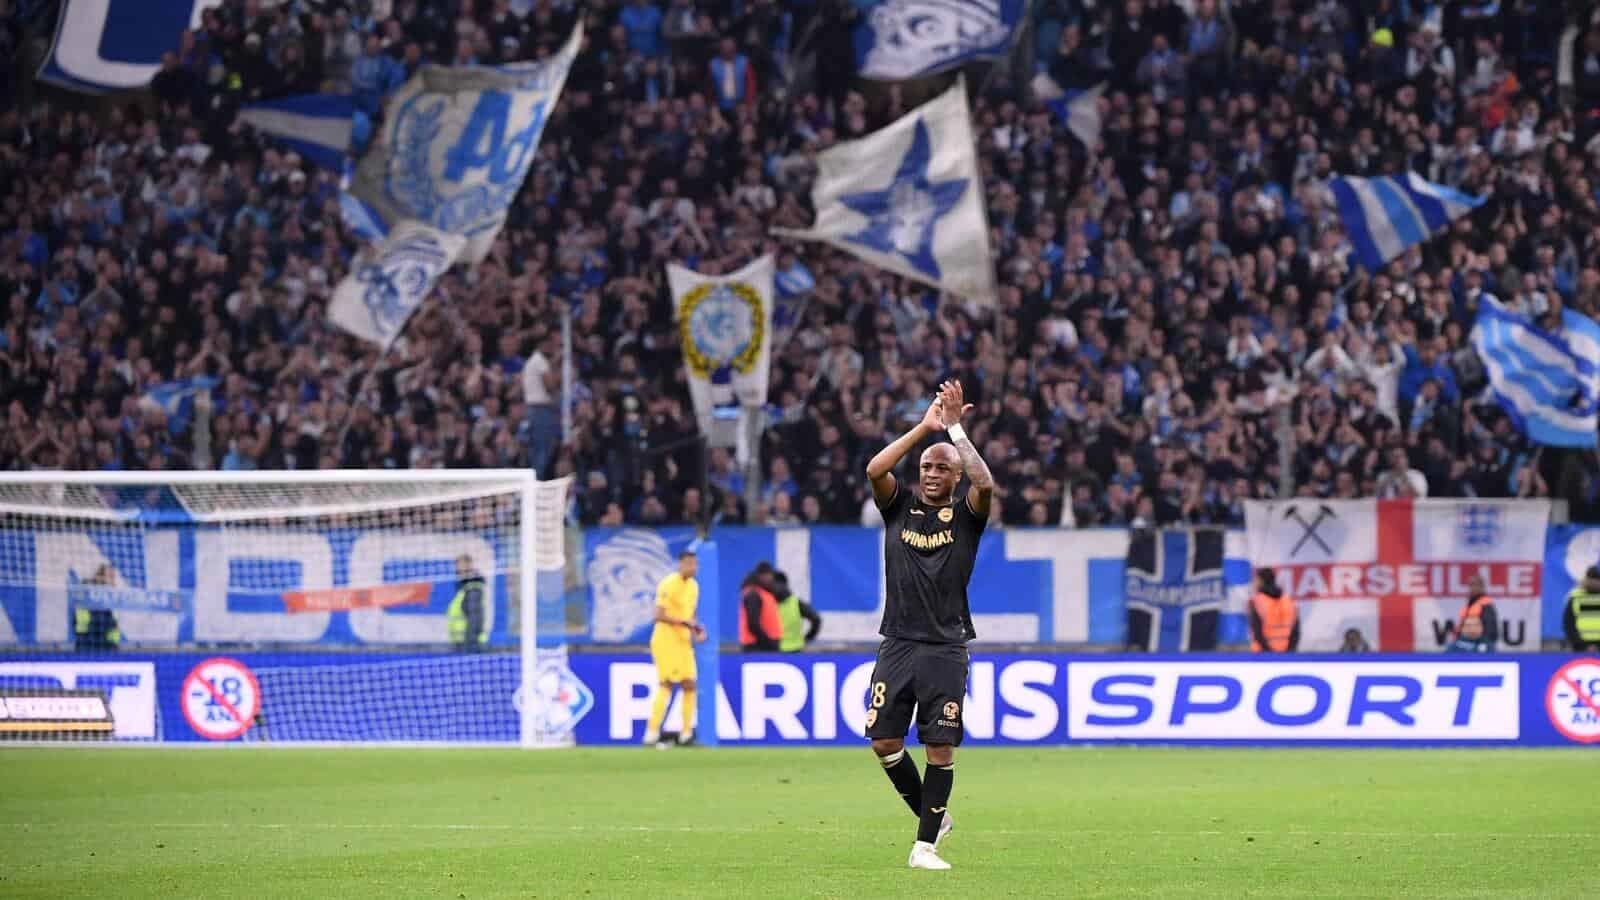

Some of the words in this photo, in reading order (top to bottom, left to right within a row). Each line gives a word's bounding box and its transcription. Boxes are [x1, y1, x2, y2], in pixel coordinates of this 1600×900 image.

[902, 529, 954, 549] WINAMAX
[0, 528, 497, 644] NDO
[1270, 564, 1535, 596] MARSEILLE
[1086, 675, 1503, 727] SPORT
